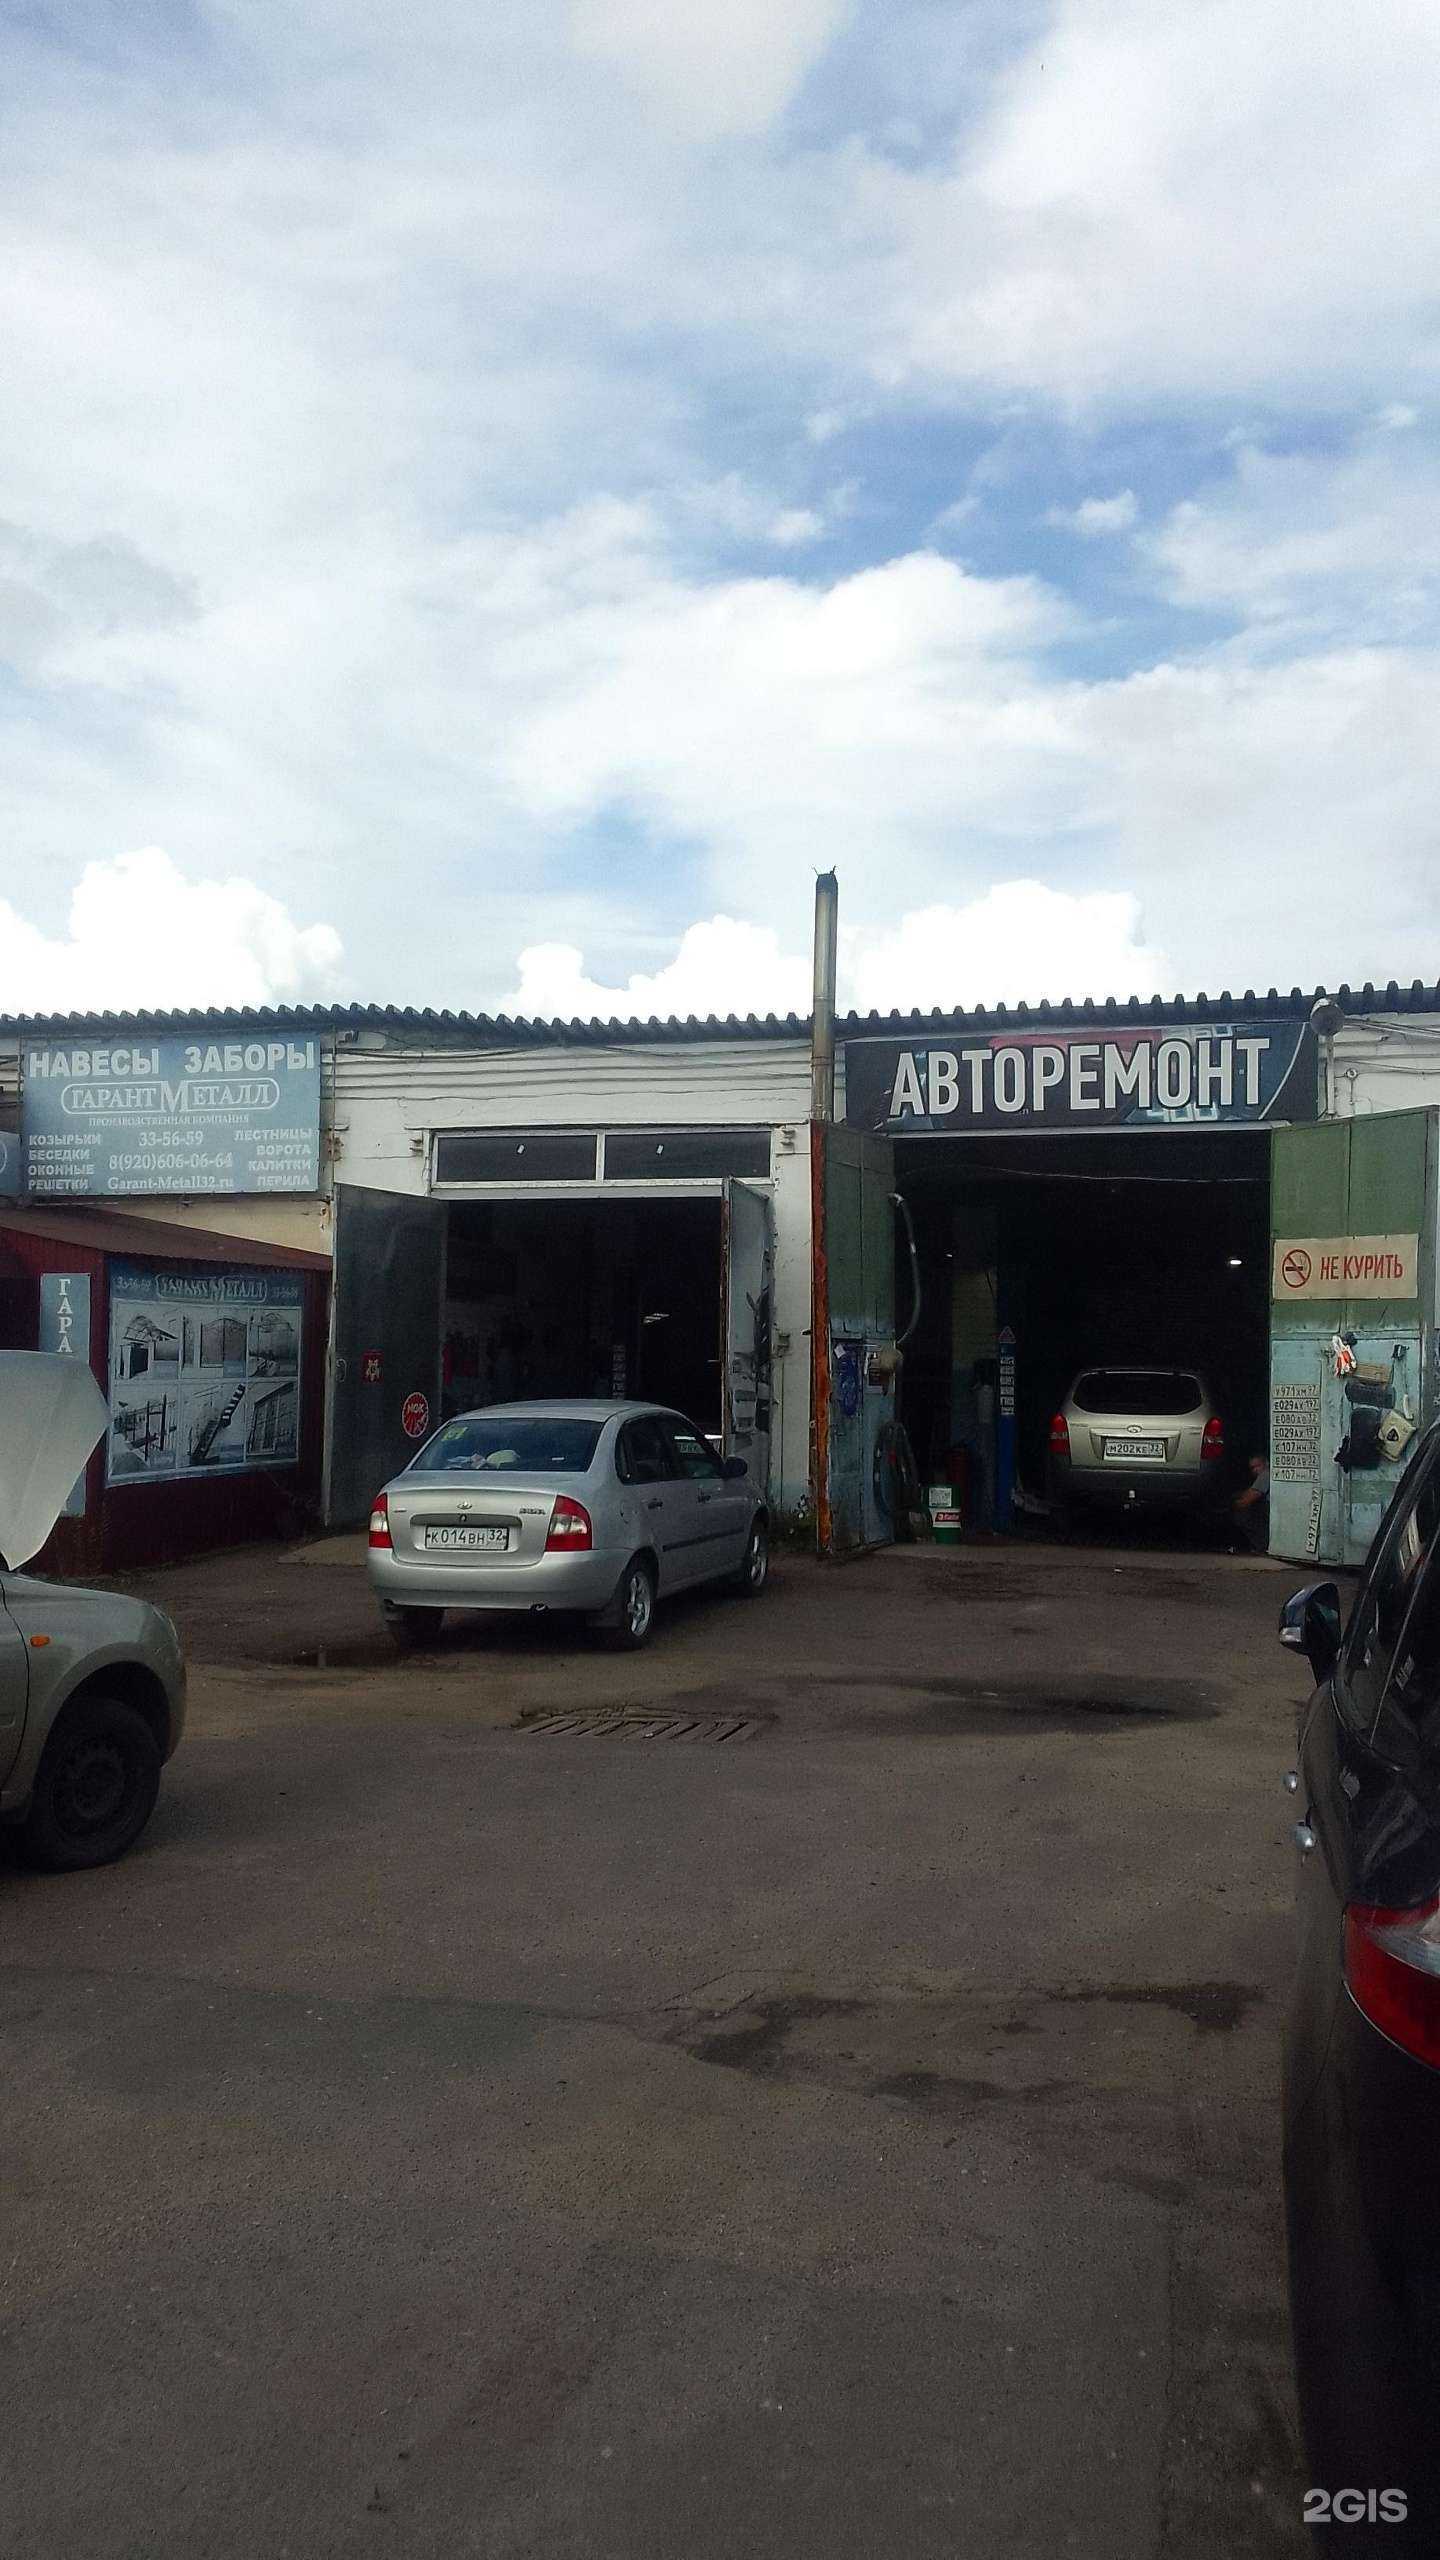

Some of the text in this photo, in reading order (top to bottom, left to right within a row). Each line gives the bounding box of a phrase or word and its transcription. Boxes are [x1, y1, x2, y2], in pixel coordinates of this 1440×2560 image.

[29, 1042, 315, 1078] НАВЕСЫ ЗАБОРЫ
[889, 1038, 1270, 1117] АВТОРЕМОНТ
[193, 1113, 249, 1125] КОМПАНИЯ
[28, 1133, 102, 1146] КОЗЫРЬКИ
[139, 1131, 204, 1147] 33-56-59
[233, 1128, 313, 1142] ЛЕСТНИЦЫ
[28, 1149, 90, 1161] БЕСЕДКИ
[256, 1144, 311, 1156] ВОРОТА
[27, 1164, 95, 1176] ОКОННЫЕ
[248, 1159, 312, 1172] КАЛИТКИ
[27, 1178, 89, 1190] РЕШЕТКИ
[107, 1175, 234, 1190] Garant-Metall32.ru
[256, 1175, 310, 1187] ПЕРИЛА
[1320, 1253, 1404, 1280] НЕ КУРИТЬ
